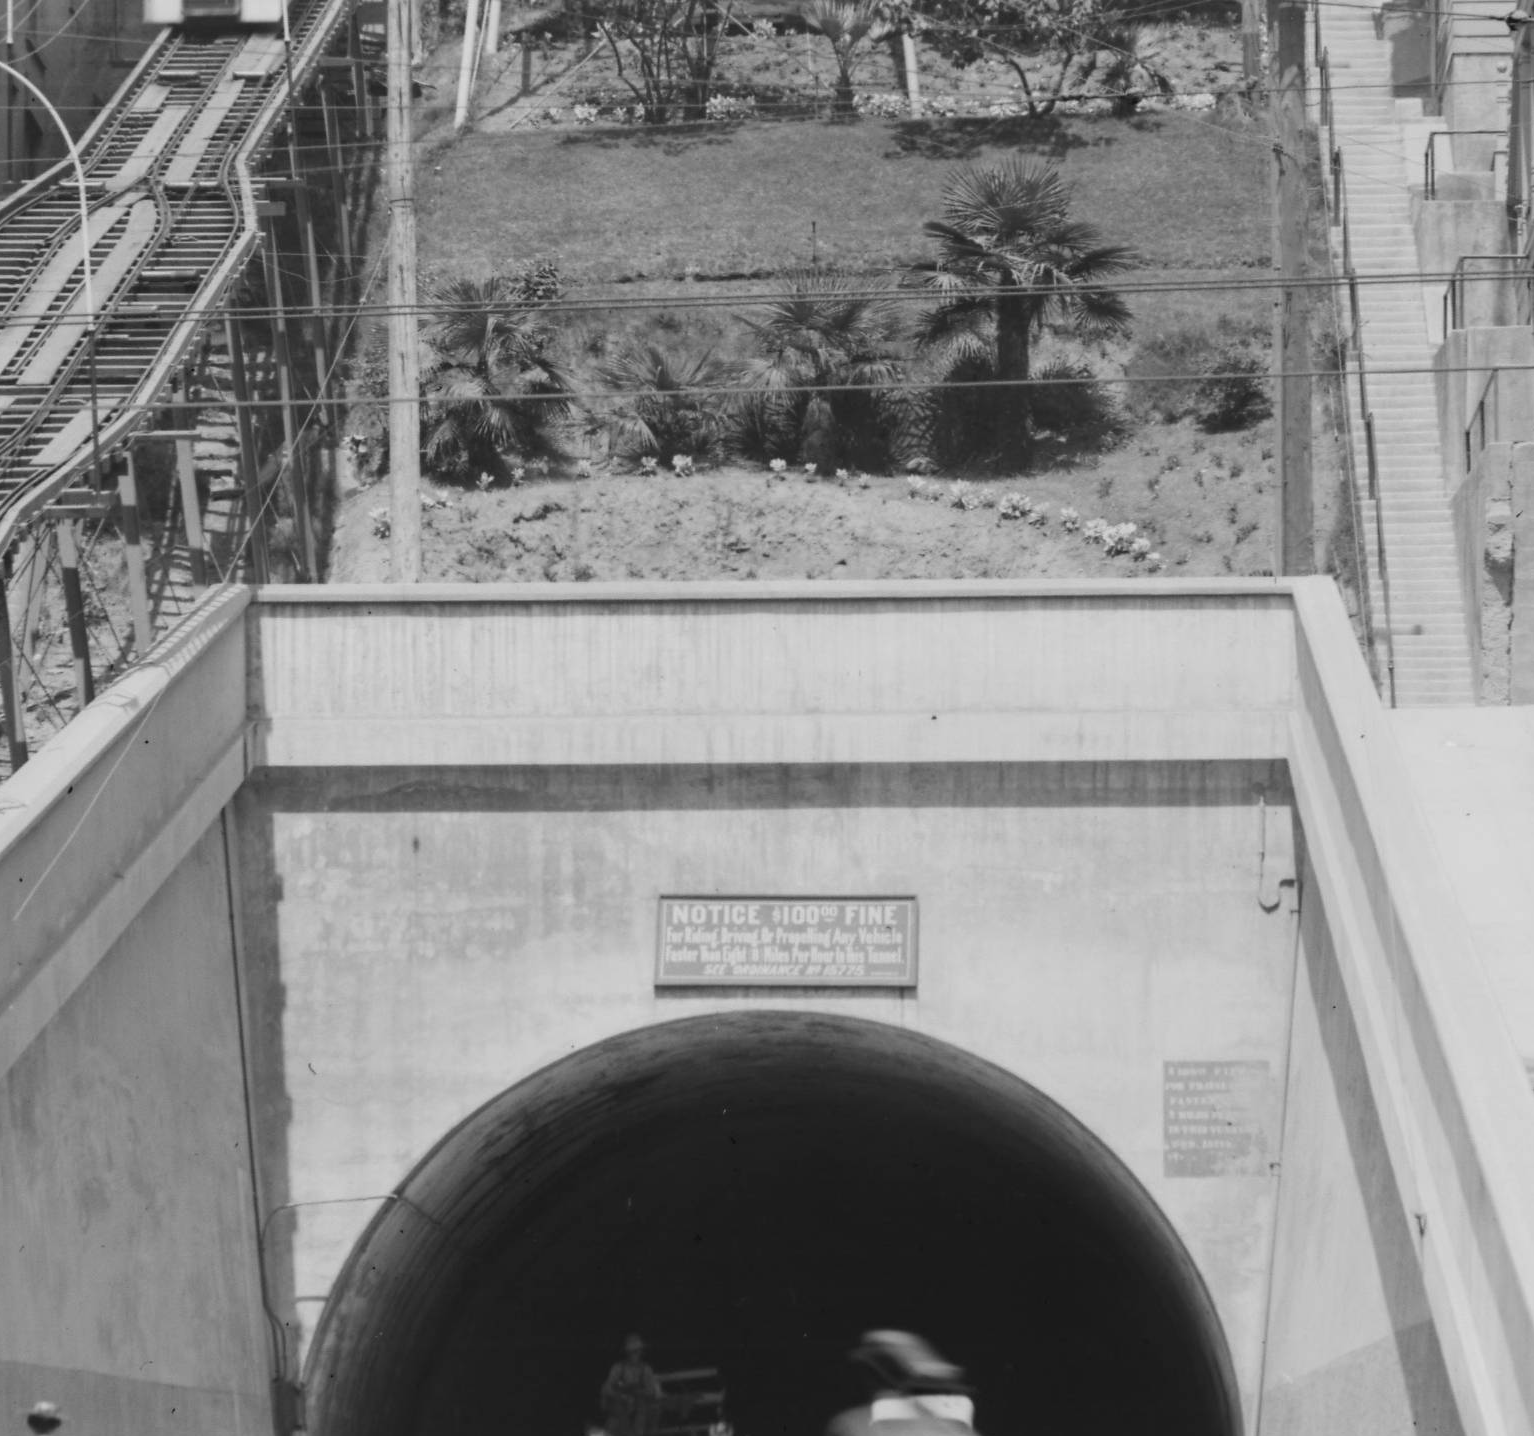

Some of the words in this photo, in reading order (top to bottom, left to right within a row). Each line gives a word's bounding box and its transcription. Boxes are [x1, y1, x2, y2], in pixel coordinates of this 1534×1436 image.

[671, 905, 761, 925] NOTICE
[844, 905, 898, 926] FINE
[831, 927, 857, 947] Any
[858, 927, 904, 945] Vehicle
